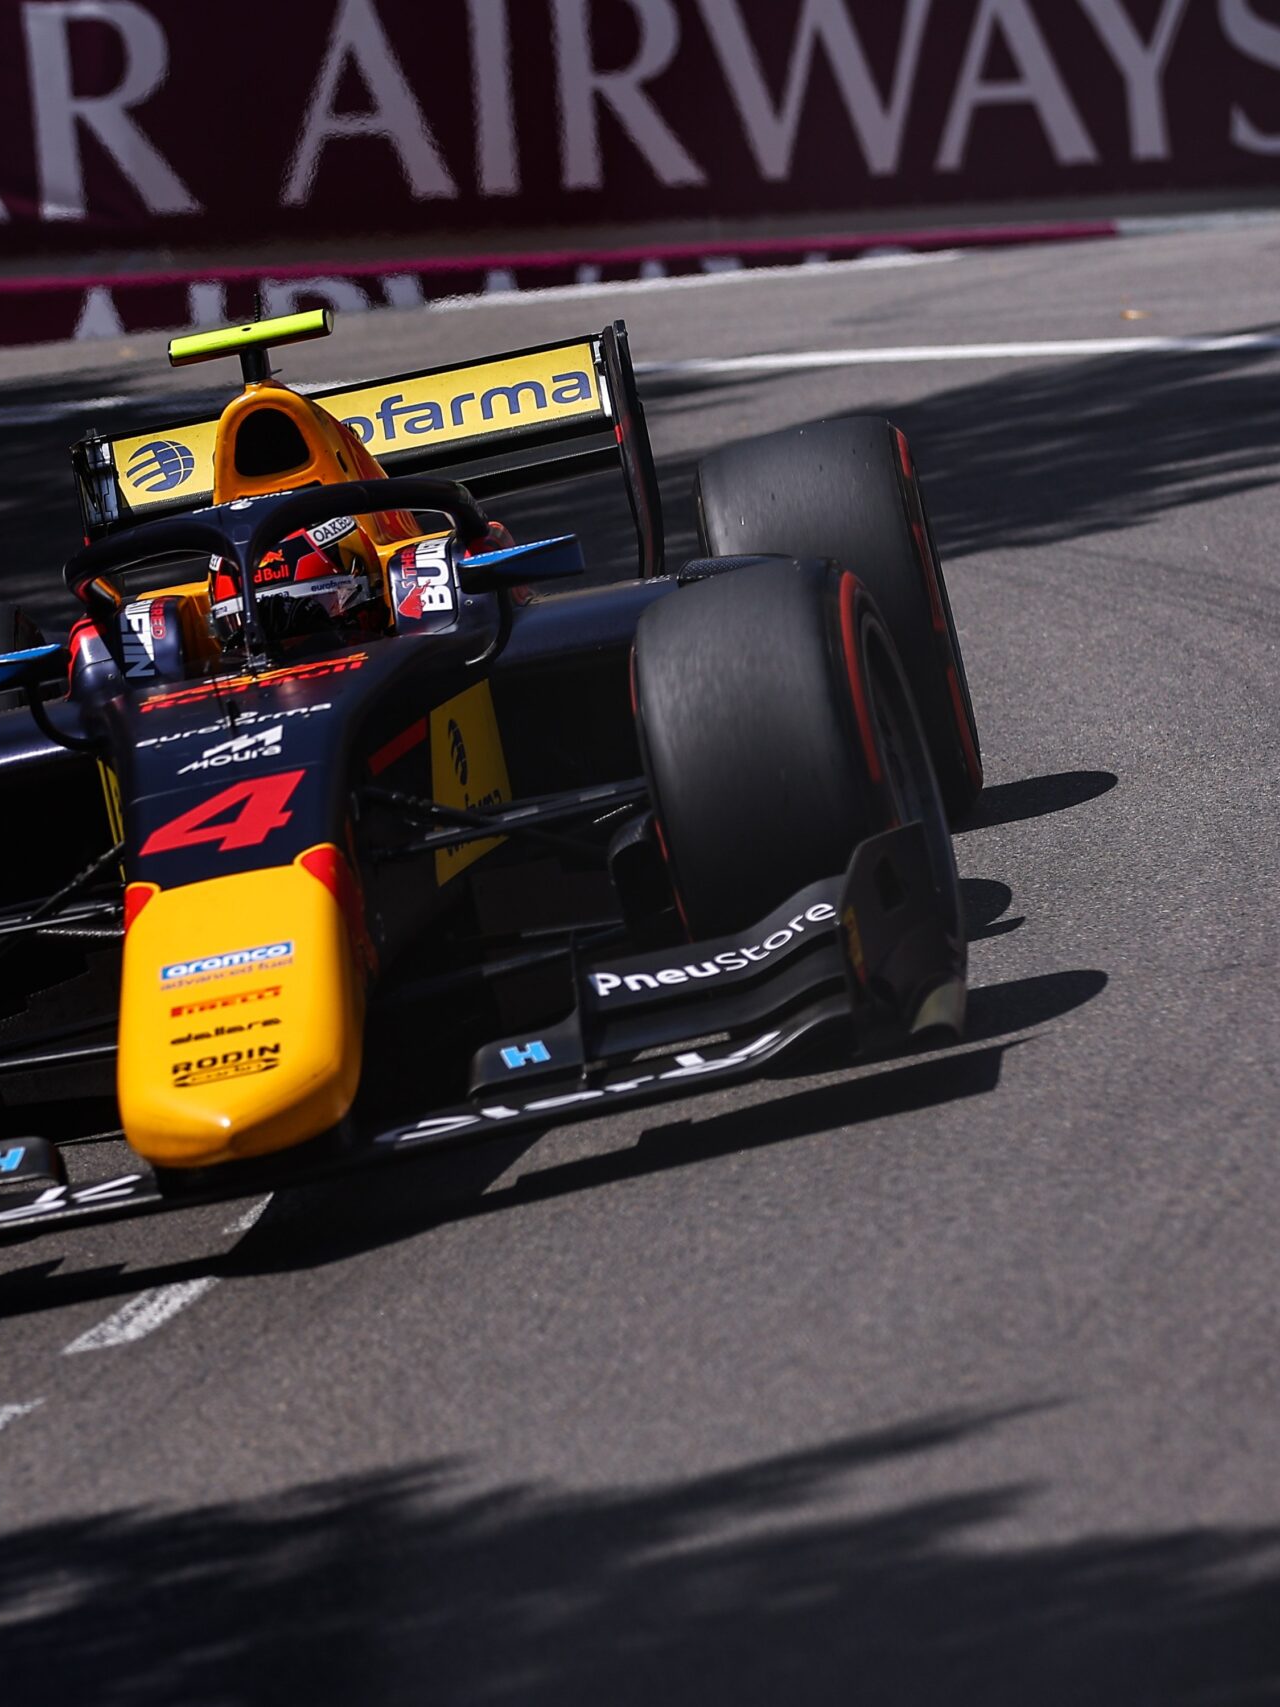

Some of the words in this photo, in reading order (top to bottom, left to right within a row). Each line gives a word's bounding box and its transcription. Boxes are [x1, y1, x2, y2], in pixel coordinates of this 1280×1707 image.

[339, 370, 593, 444] ofarma
[138, 769, 307, 857] 4
[166, 944, 289, 979] aramco
[588, 901, 837, 997] PneuStore
[172, 1042, 280, 1075] RODIN
